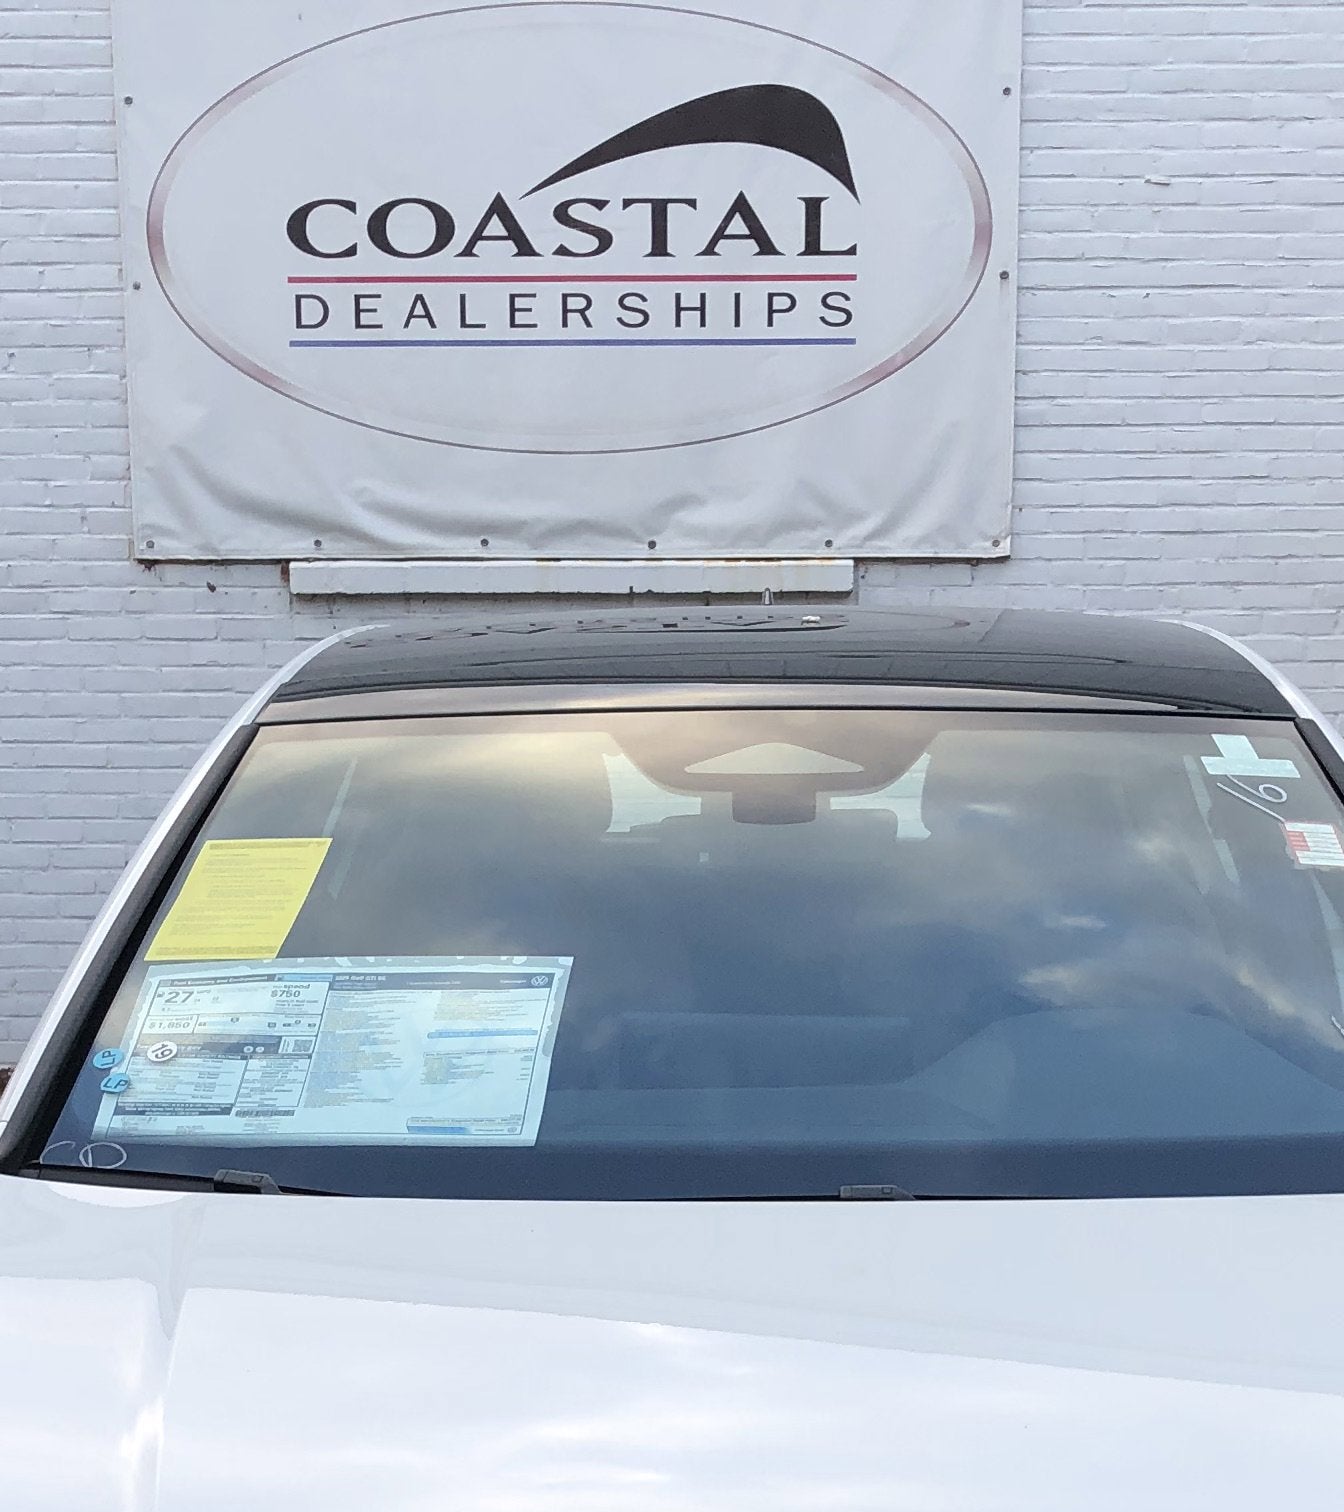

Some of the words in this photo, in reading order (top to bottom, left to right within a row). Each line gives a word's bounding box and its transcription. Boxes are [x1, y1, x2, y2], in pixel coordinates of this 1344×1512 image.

[286, 191, 858, 259] COASTAL
[294, 291, 854, 330] DEALERSHIPS
[164, 991, 195, 1004] 27
[103, 1077, 129, 1089] LP
